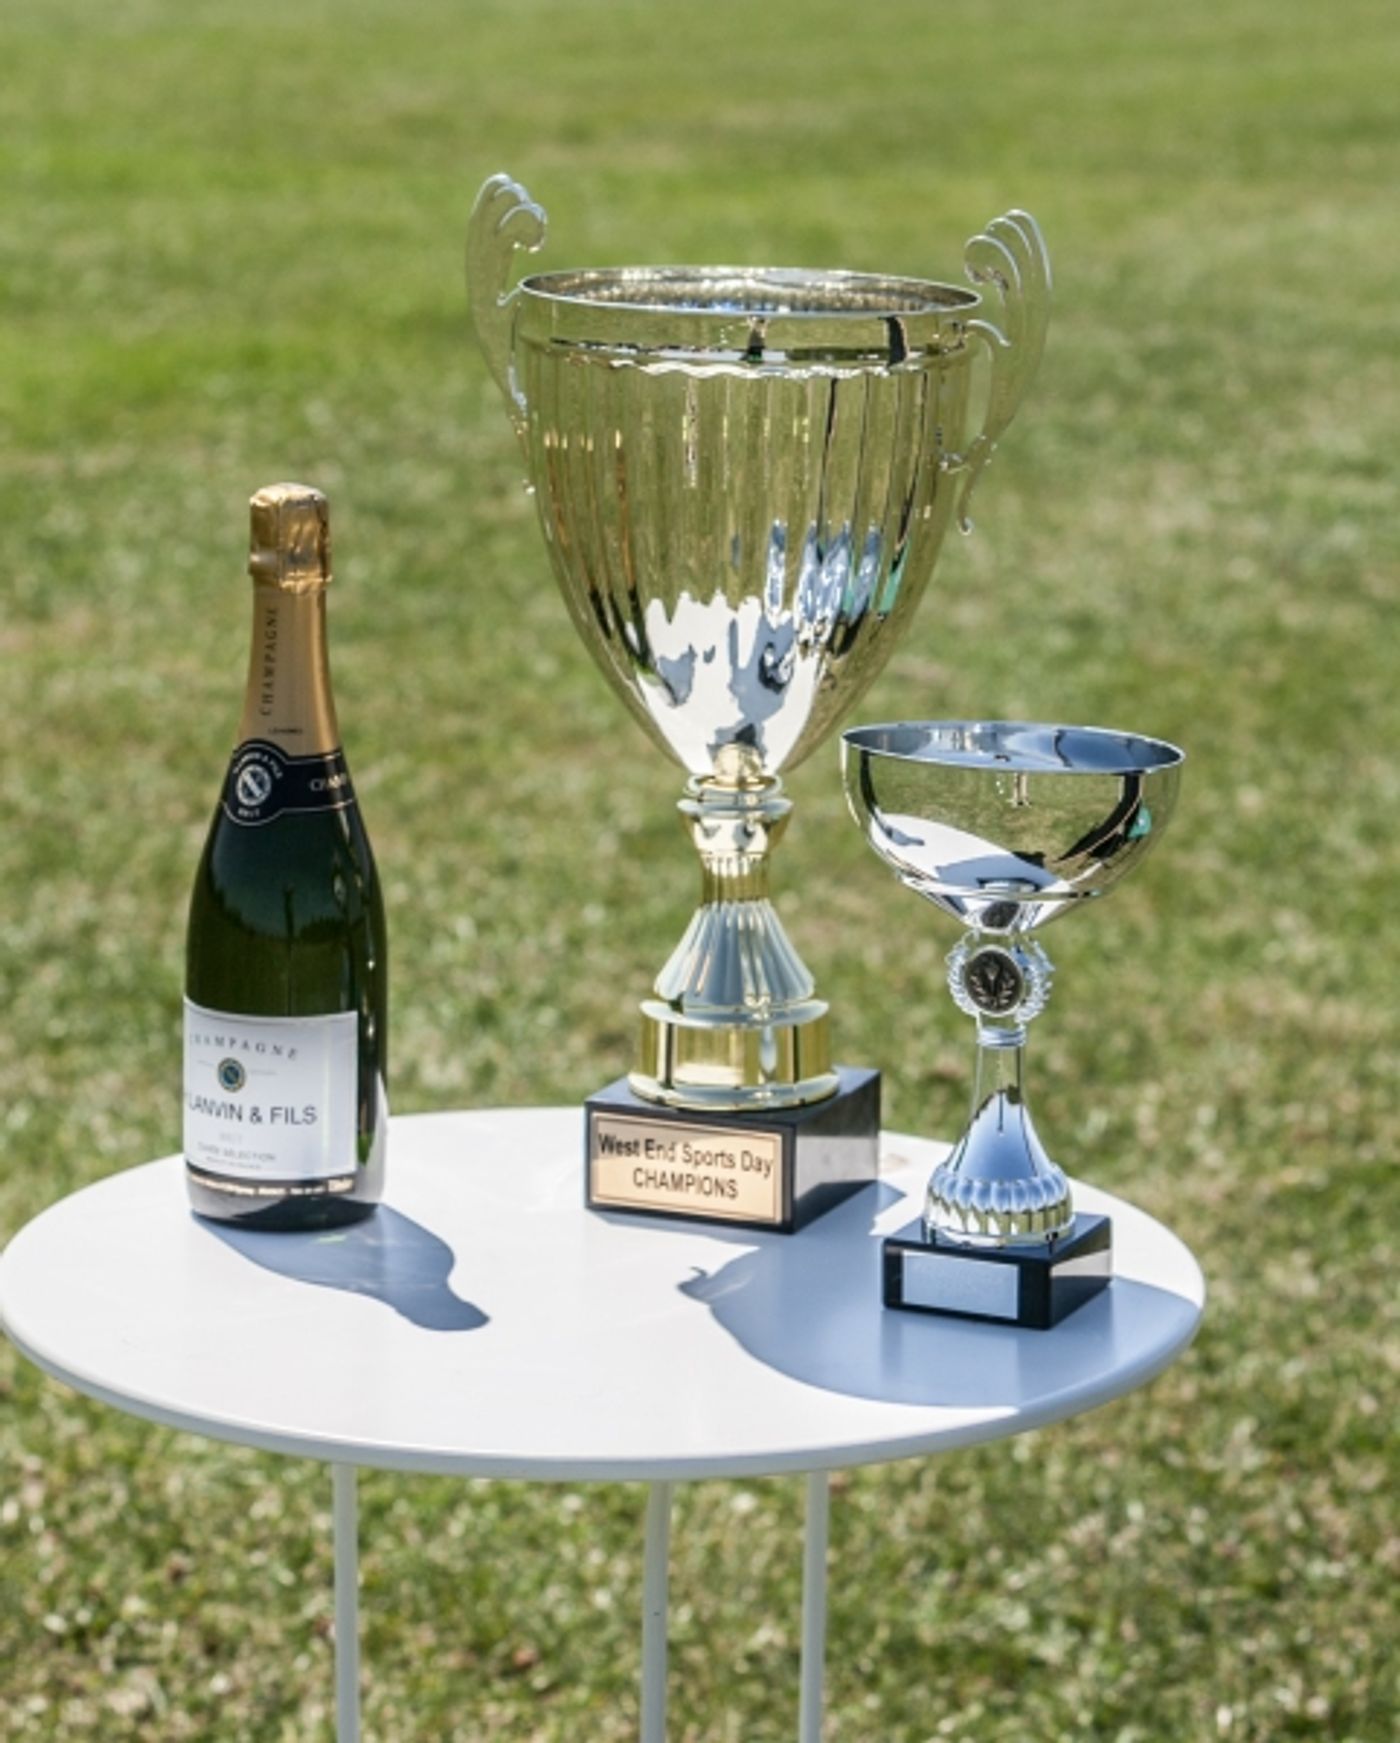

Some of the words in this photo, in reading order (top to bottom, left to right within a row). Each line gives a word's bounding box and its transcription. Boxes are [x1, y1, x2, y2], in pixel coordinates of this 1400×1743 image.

[259, 606, 278, 716] CHAMPAGNE
[189, 1032, 298, 1060] HAMPAGNE
[249, 1105, 263, 1124] &
[269, 1105, 319, 1126] FILS
[599, 1132, 640, 1156] West
[644, 1138, 675, 1162] End
[682, 1143, 735, 1170] Sports
[740, 1150, 773, 1178] Day
[633, 1167, 738, 1199] CHAMPIONS
